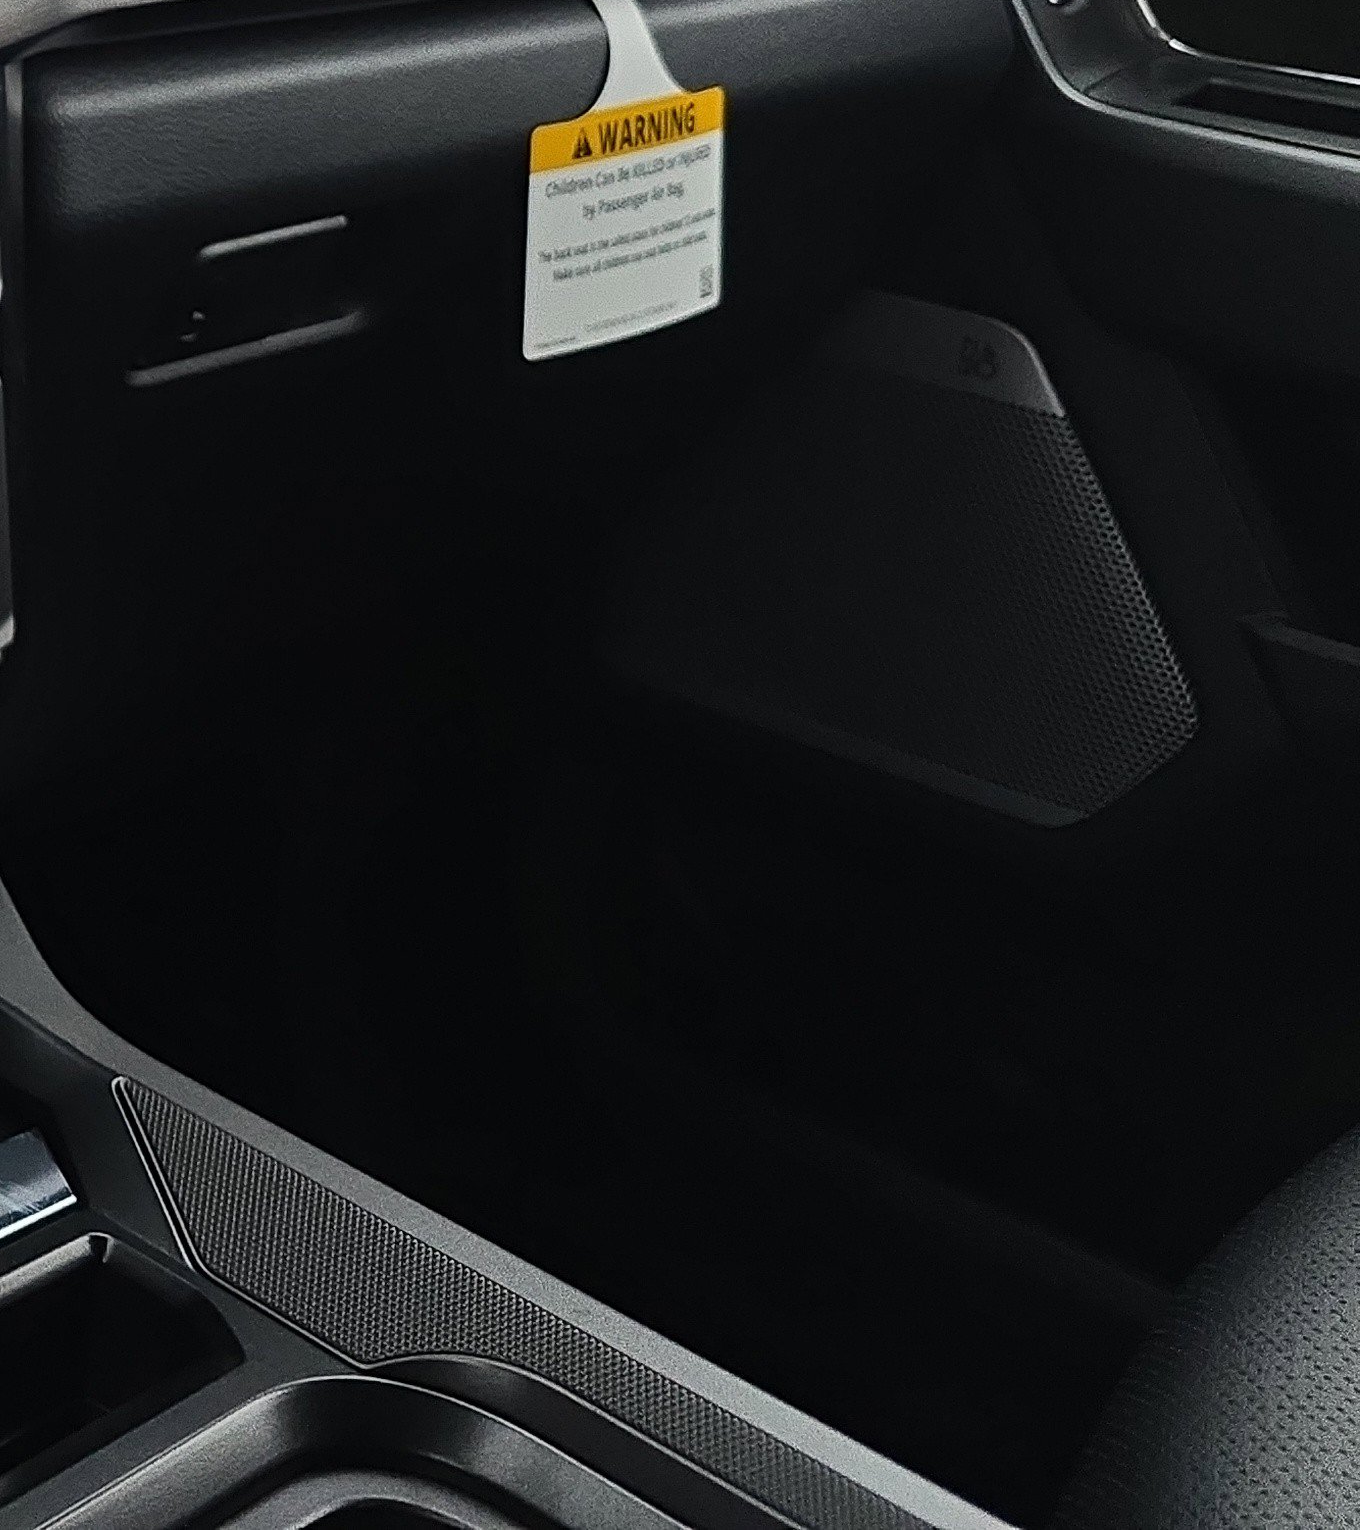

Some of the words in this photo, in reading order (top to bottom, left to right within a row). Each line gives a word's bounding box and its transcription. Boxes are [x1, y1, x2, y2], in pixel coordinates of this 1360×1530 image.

[598, 102, 696, 155] WARNING
[545, 177, 593, 198] Children
[595, 171, 616, 188] Can
[598, 191, 649, 214] Passenger
